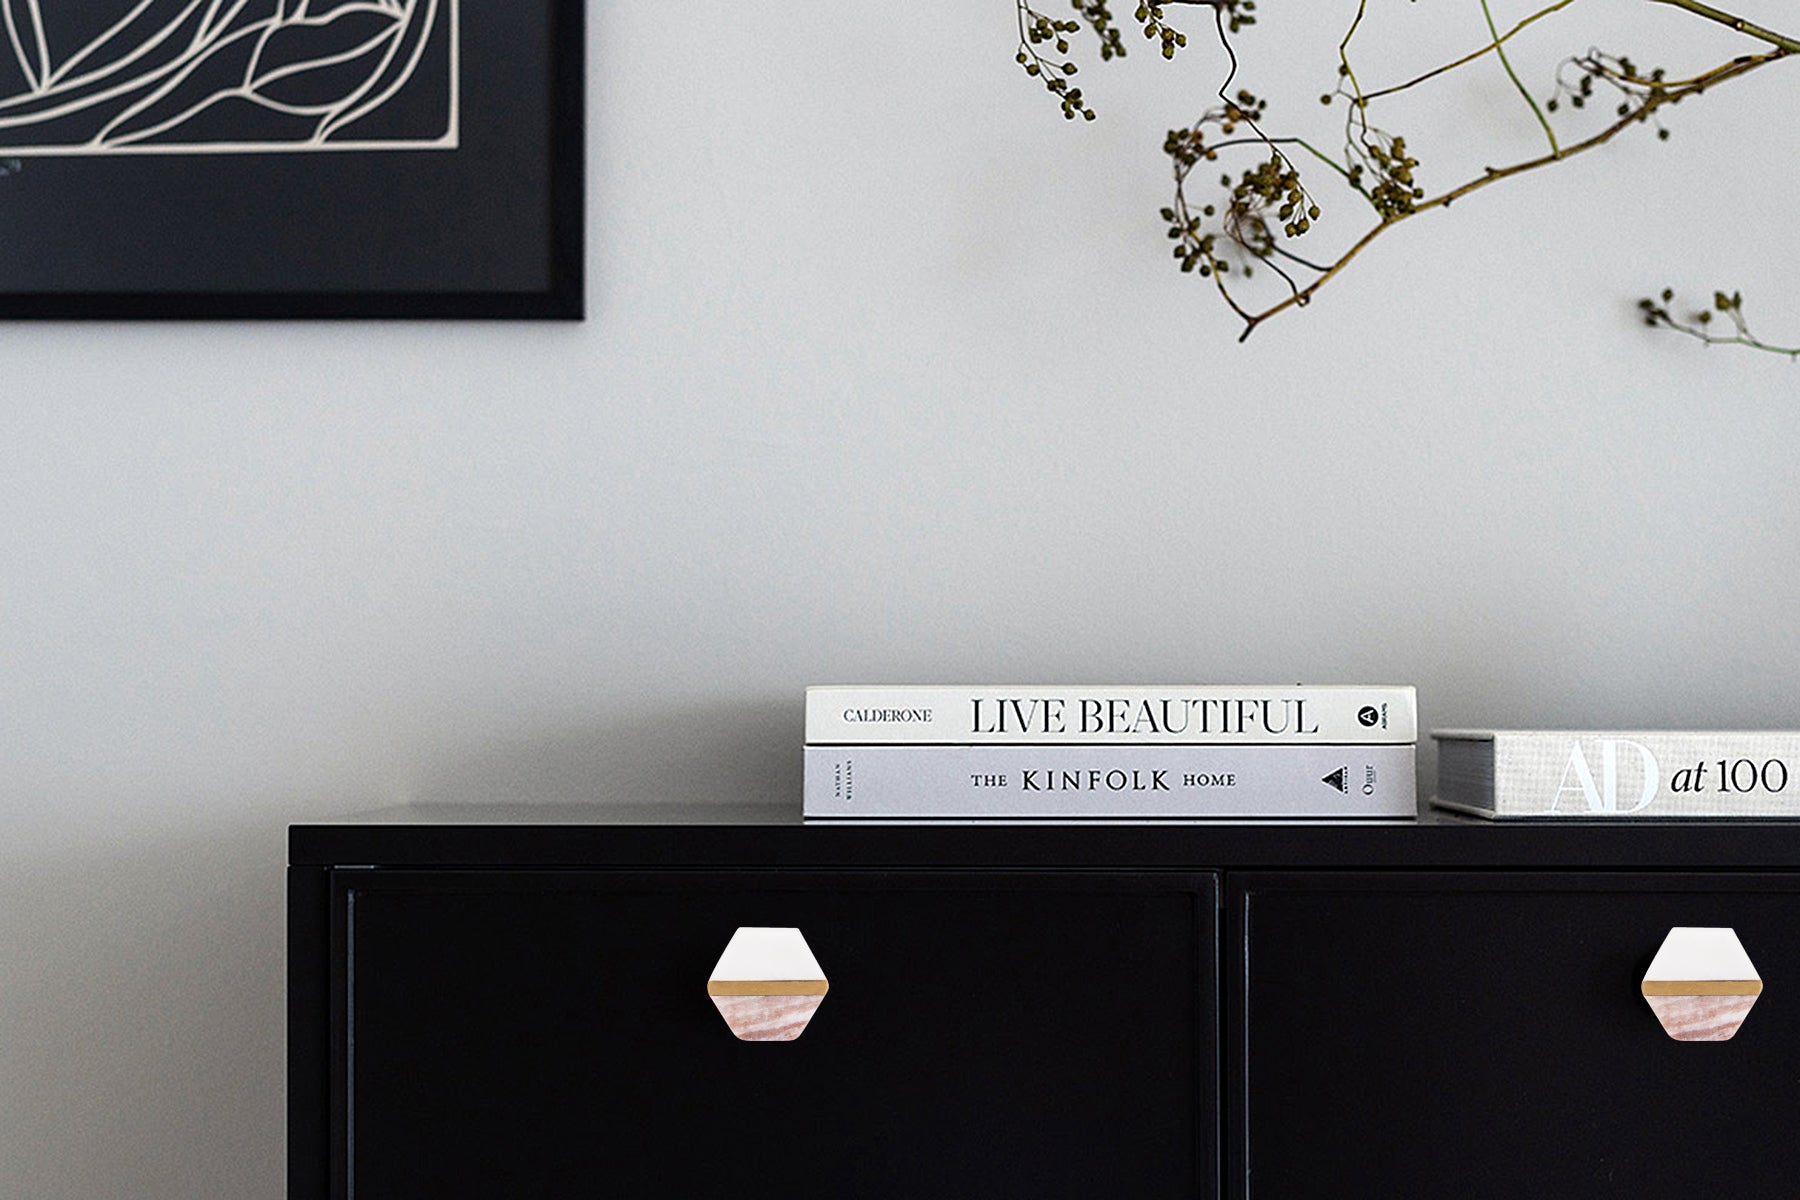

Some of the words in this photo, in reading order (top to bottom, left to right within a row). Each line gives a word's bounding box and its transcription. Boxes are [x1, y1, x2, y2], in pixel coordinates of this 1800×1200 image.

[843, 708, 933, 722] CALDERONE
[972, 699, 1066, 733] LIVE
[1079, 699, 1319, 733] BEAUTIFUL
[1359, 708, 1376, 725] A
[971, 774, 1008, 787] THE
[1022, 770, 1170, 791] KINFOLK
[1183, 774, 1236, 787] HOME
[1544, 739, 1660, 815] AD
[1670, 761, 1708, 793] at
[1717, 758, 1788, 793] 100
